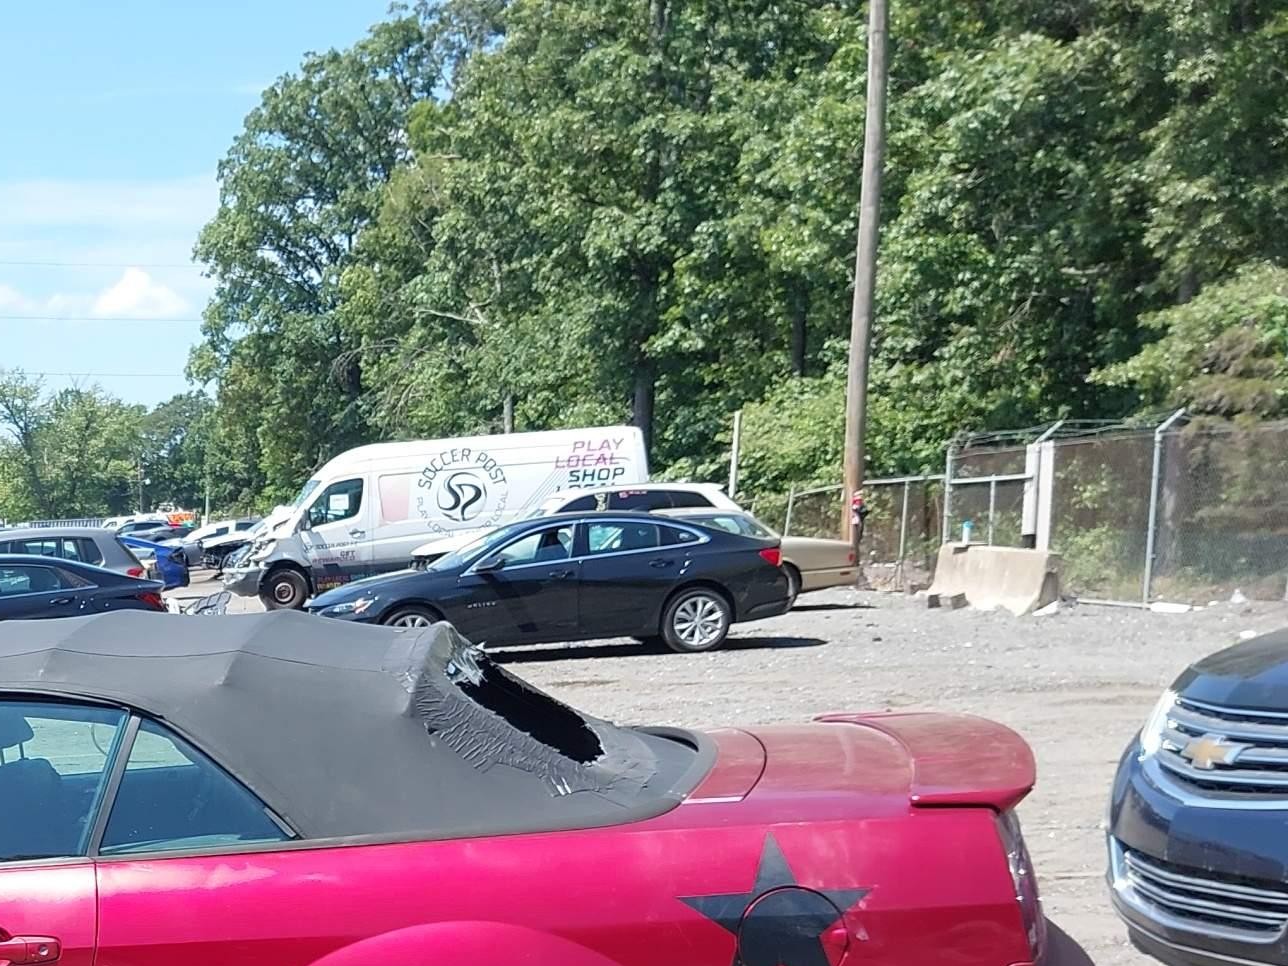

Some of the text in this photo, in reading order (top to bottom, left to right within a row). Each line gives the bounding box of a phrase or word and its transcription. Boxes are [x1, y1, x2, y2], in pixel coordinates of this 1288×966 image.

[572, 437, 624, 452] PLAY
[555, 452, 620, 468] LOCAL
[418, 448, 508, 489] SOCCER POST
[568, 467, 625, 483] SHOP
